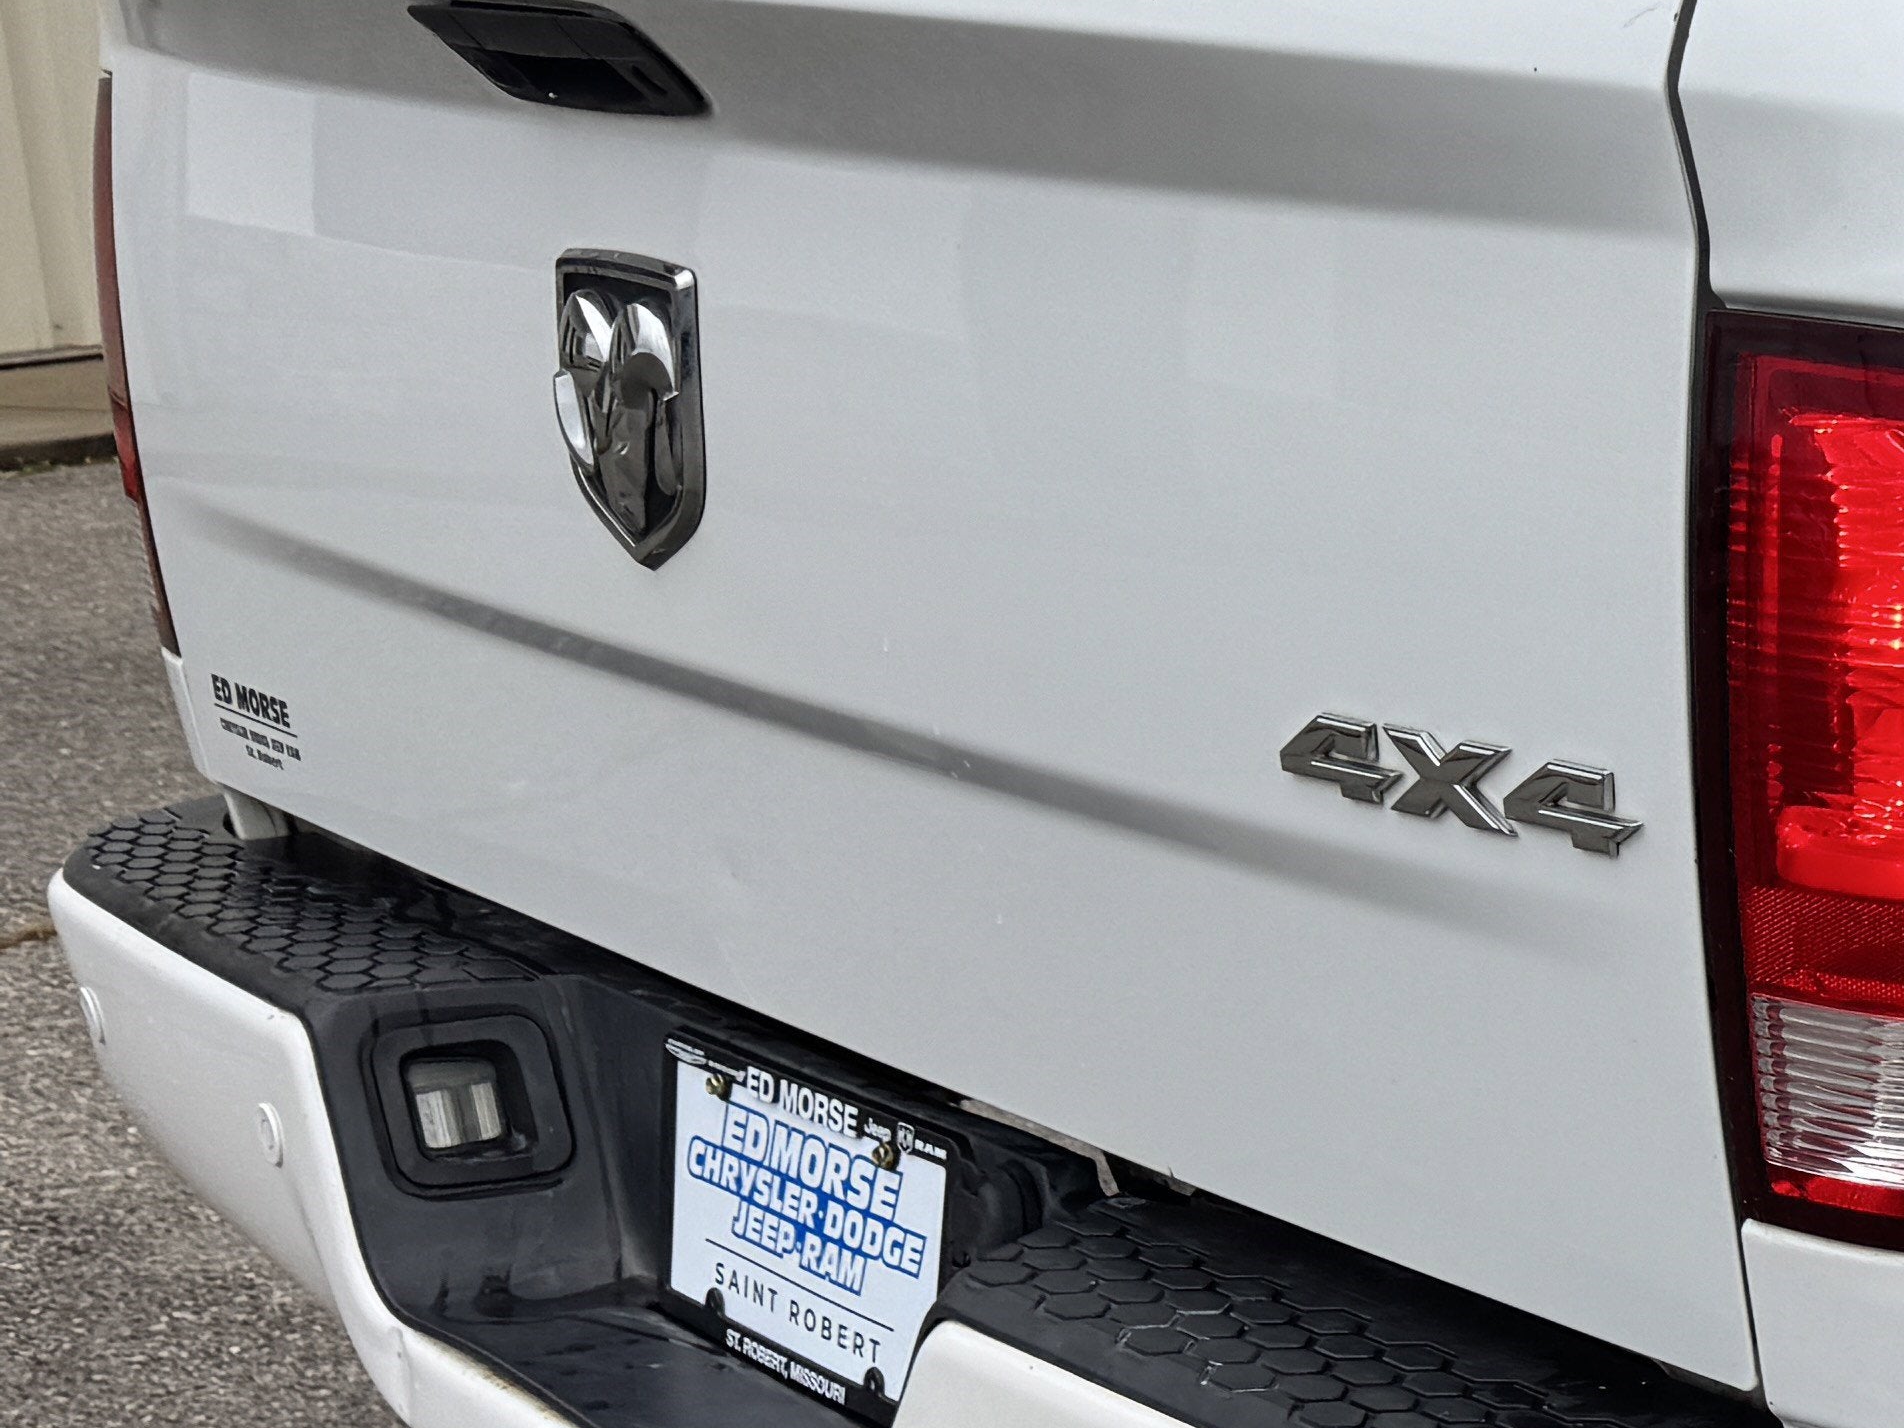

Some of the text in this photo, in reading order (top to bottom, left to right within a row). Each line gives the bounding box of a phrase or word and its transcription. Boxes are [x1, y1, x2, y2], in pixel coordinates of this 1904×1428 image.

[211, 673, 291, 729] ED MORSE
[746, 1065, 775, 1104] ED
[779, 1078, 859, 1139] MORSE
[914, 1138, 947, 1160] RAM
[722, 1103, 903, 1222] ED MORSE
[714, 1262, 882, 1364] SAINT ROBERT
[790, 1362, 846, 1405] MISSOURI
